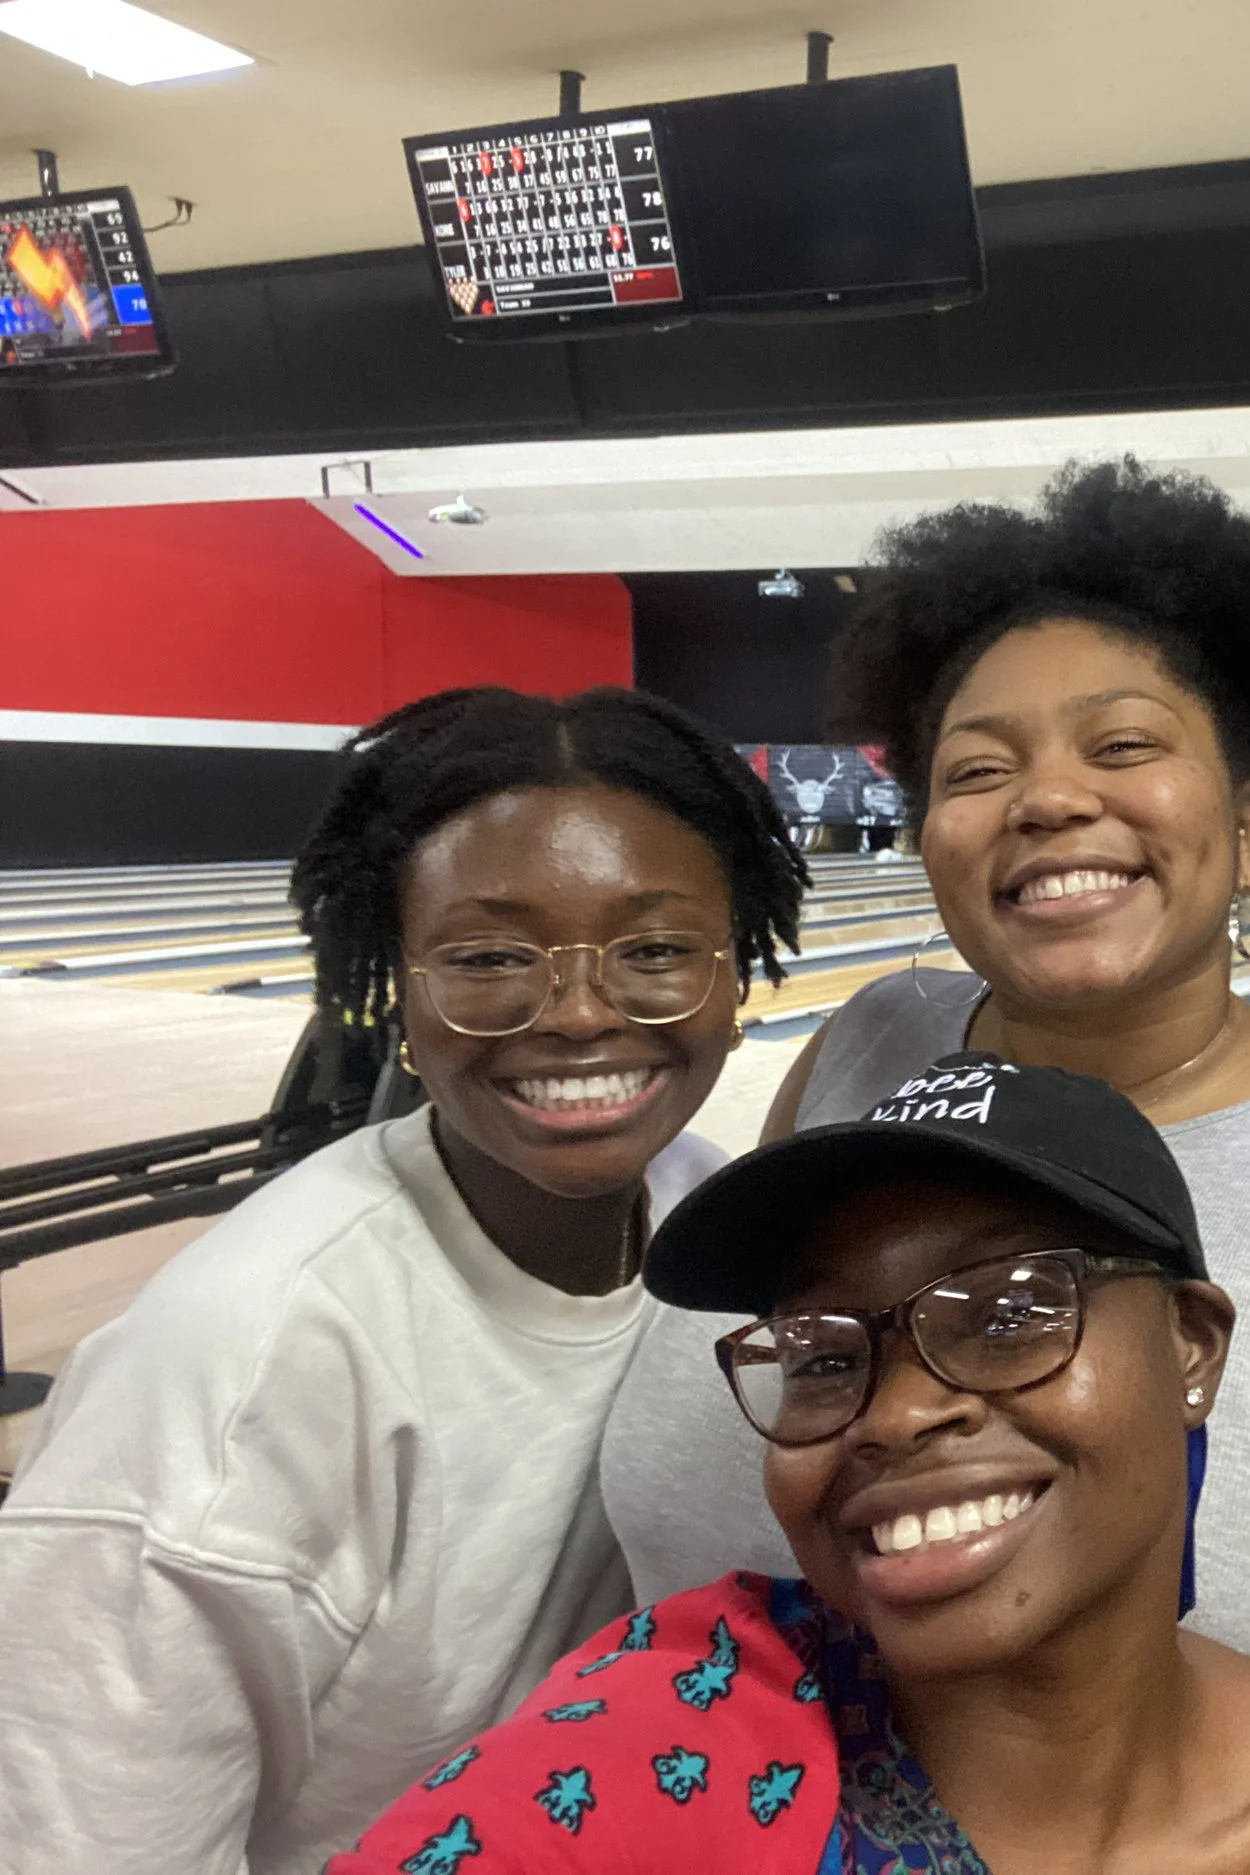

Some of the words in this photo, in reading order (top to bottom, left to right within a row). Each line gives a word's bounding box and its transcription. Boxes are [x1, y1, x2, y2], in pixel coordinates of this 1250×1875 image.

[634, 146, 653, 162] 77
[642, 191, 663, 207] 78
[112, 232, 128, 244] 92
[650, 236, 671, 251] 76
[118, 251, 134, 263] 42
[123, 270, 139, 283] 94
